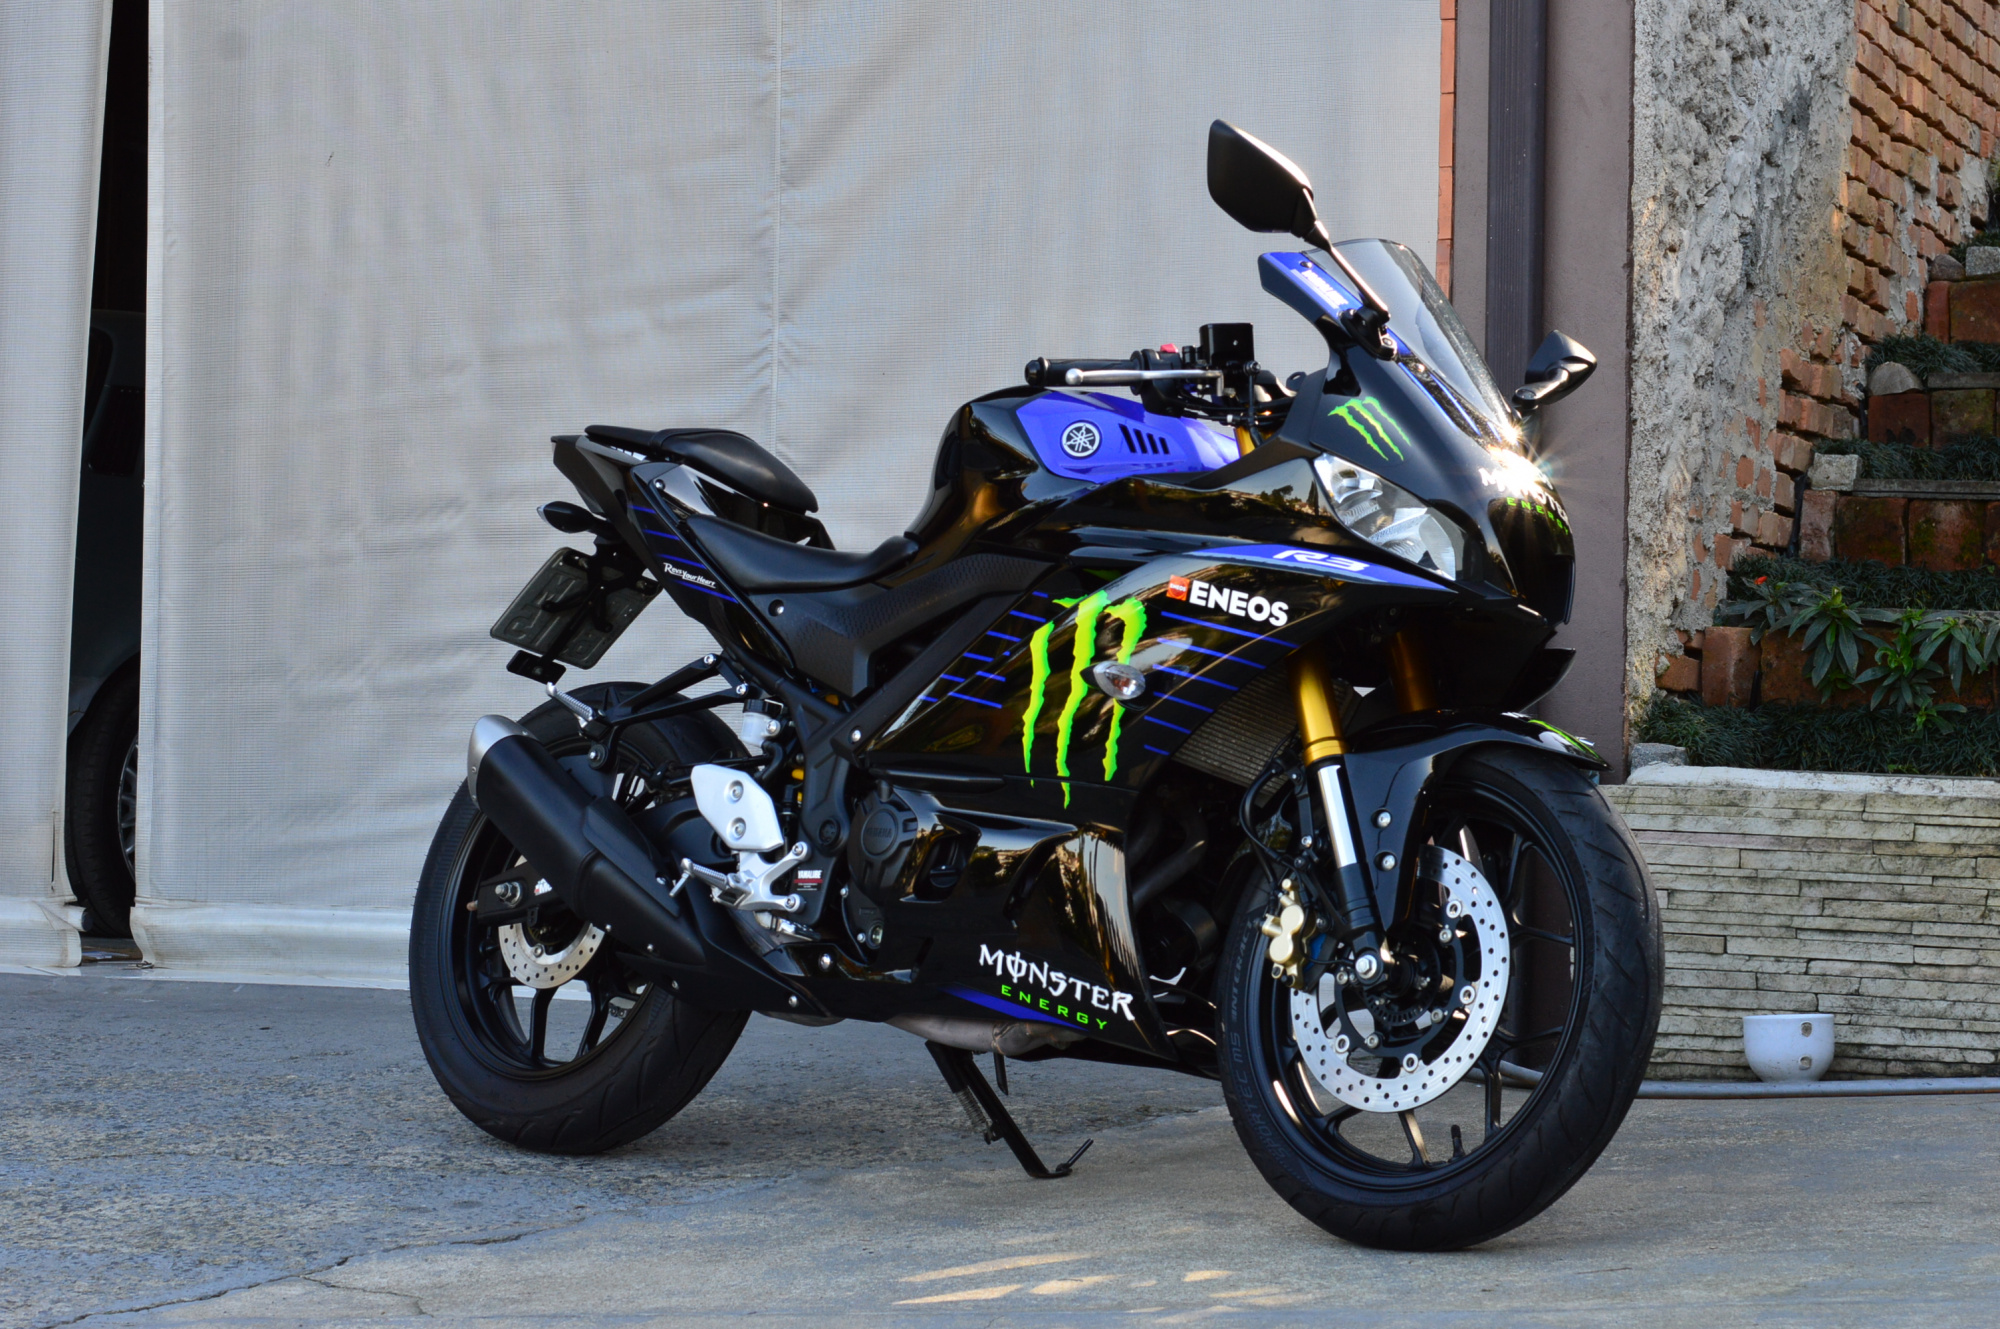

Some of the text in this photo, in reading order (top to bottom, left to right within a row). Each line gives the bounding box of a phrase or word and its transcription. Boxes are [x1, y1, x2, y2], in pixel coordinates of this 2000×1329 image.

[1273, 549, 1370, 572] R3
[1189, 580, 1289, 627] ENEOS
[979, 943, 1136, 1021] MONSTER
[1001, 984, 1108, 1030] ENERGY
